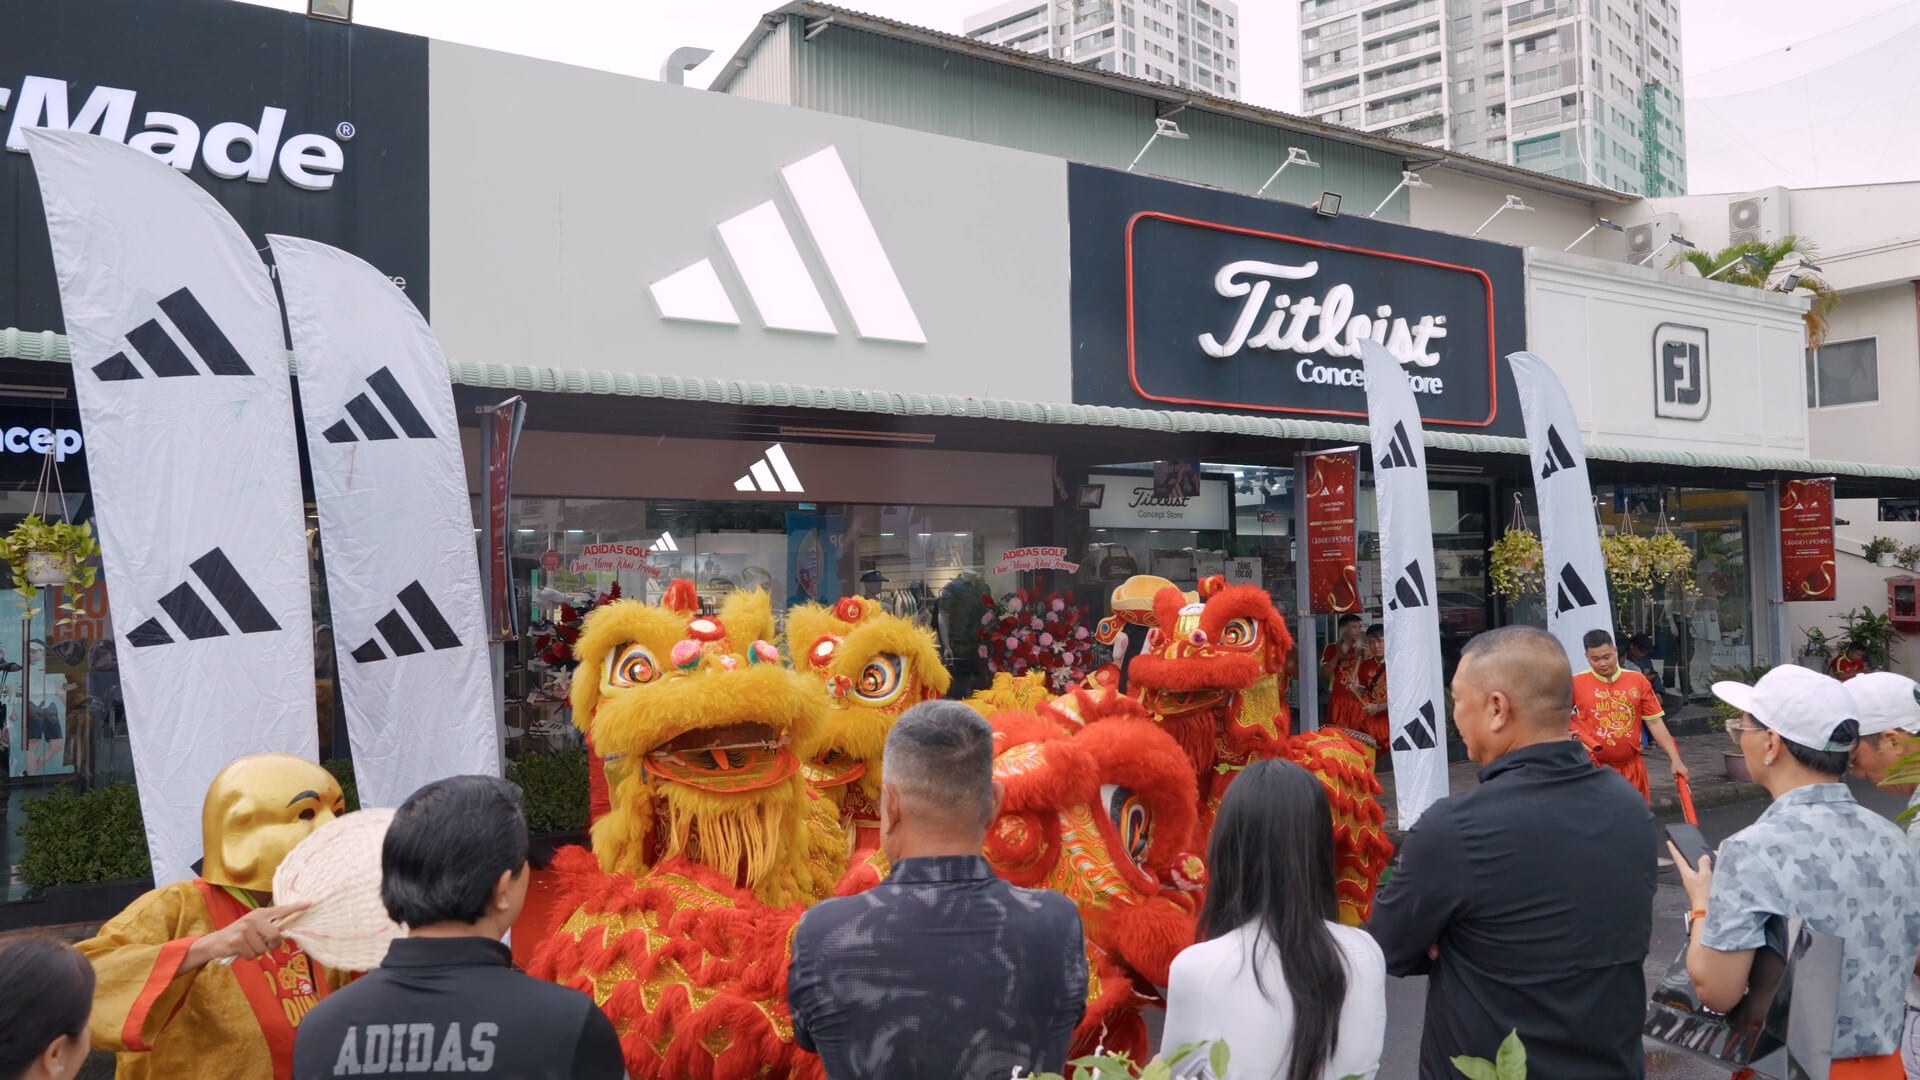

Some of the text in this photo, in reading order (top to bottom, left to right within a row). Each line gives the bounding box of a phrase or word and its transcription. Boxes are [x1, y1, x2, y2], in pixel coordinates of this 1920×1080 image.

[0, 75, 345, 191] Made
[1198, 260, 1447, 367] Titleist
[1296, 359, 1367, 392] Conce
[1138, 510, 1184, 520] Concept Store
[584, 544, 651, 559] ADIDAS GOLF
[1003, 548, 1066, 560] ADIDAS GOLF
[333, 1022, 499, 1076] ADIDAS
